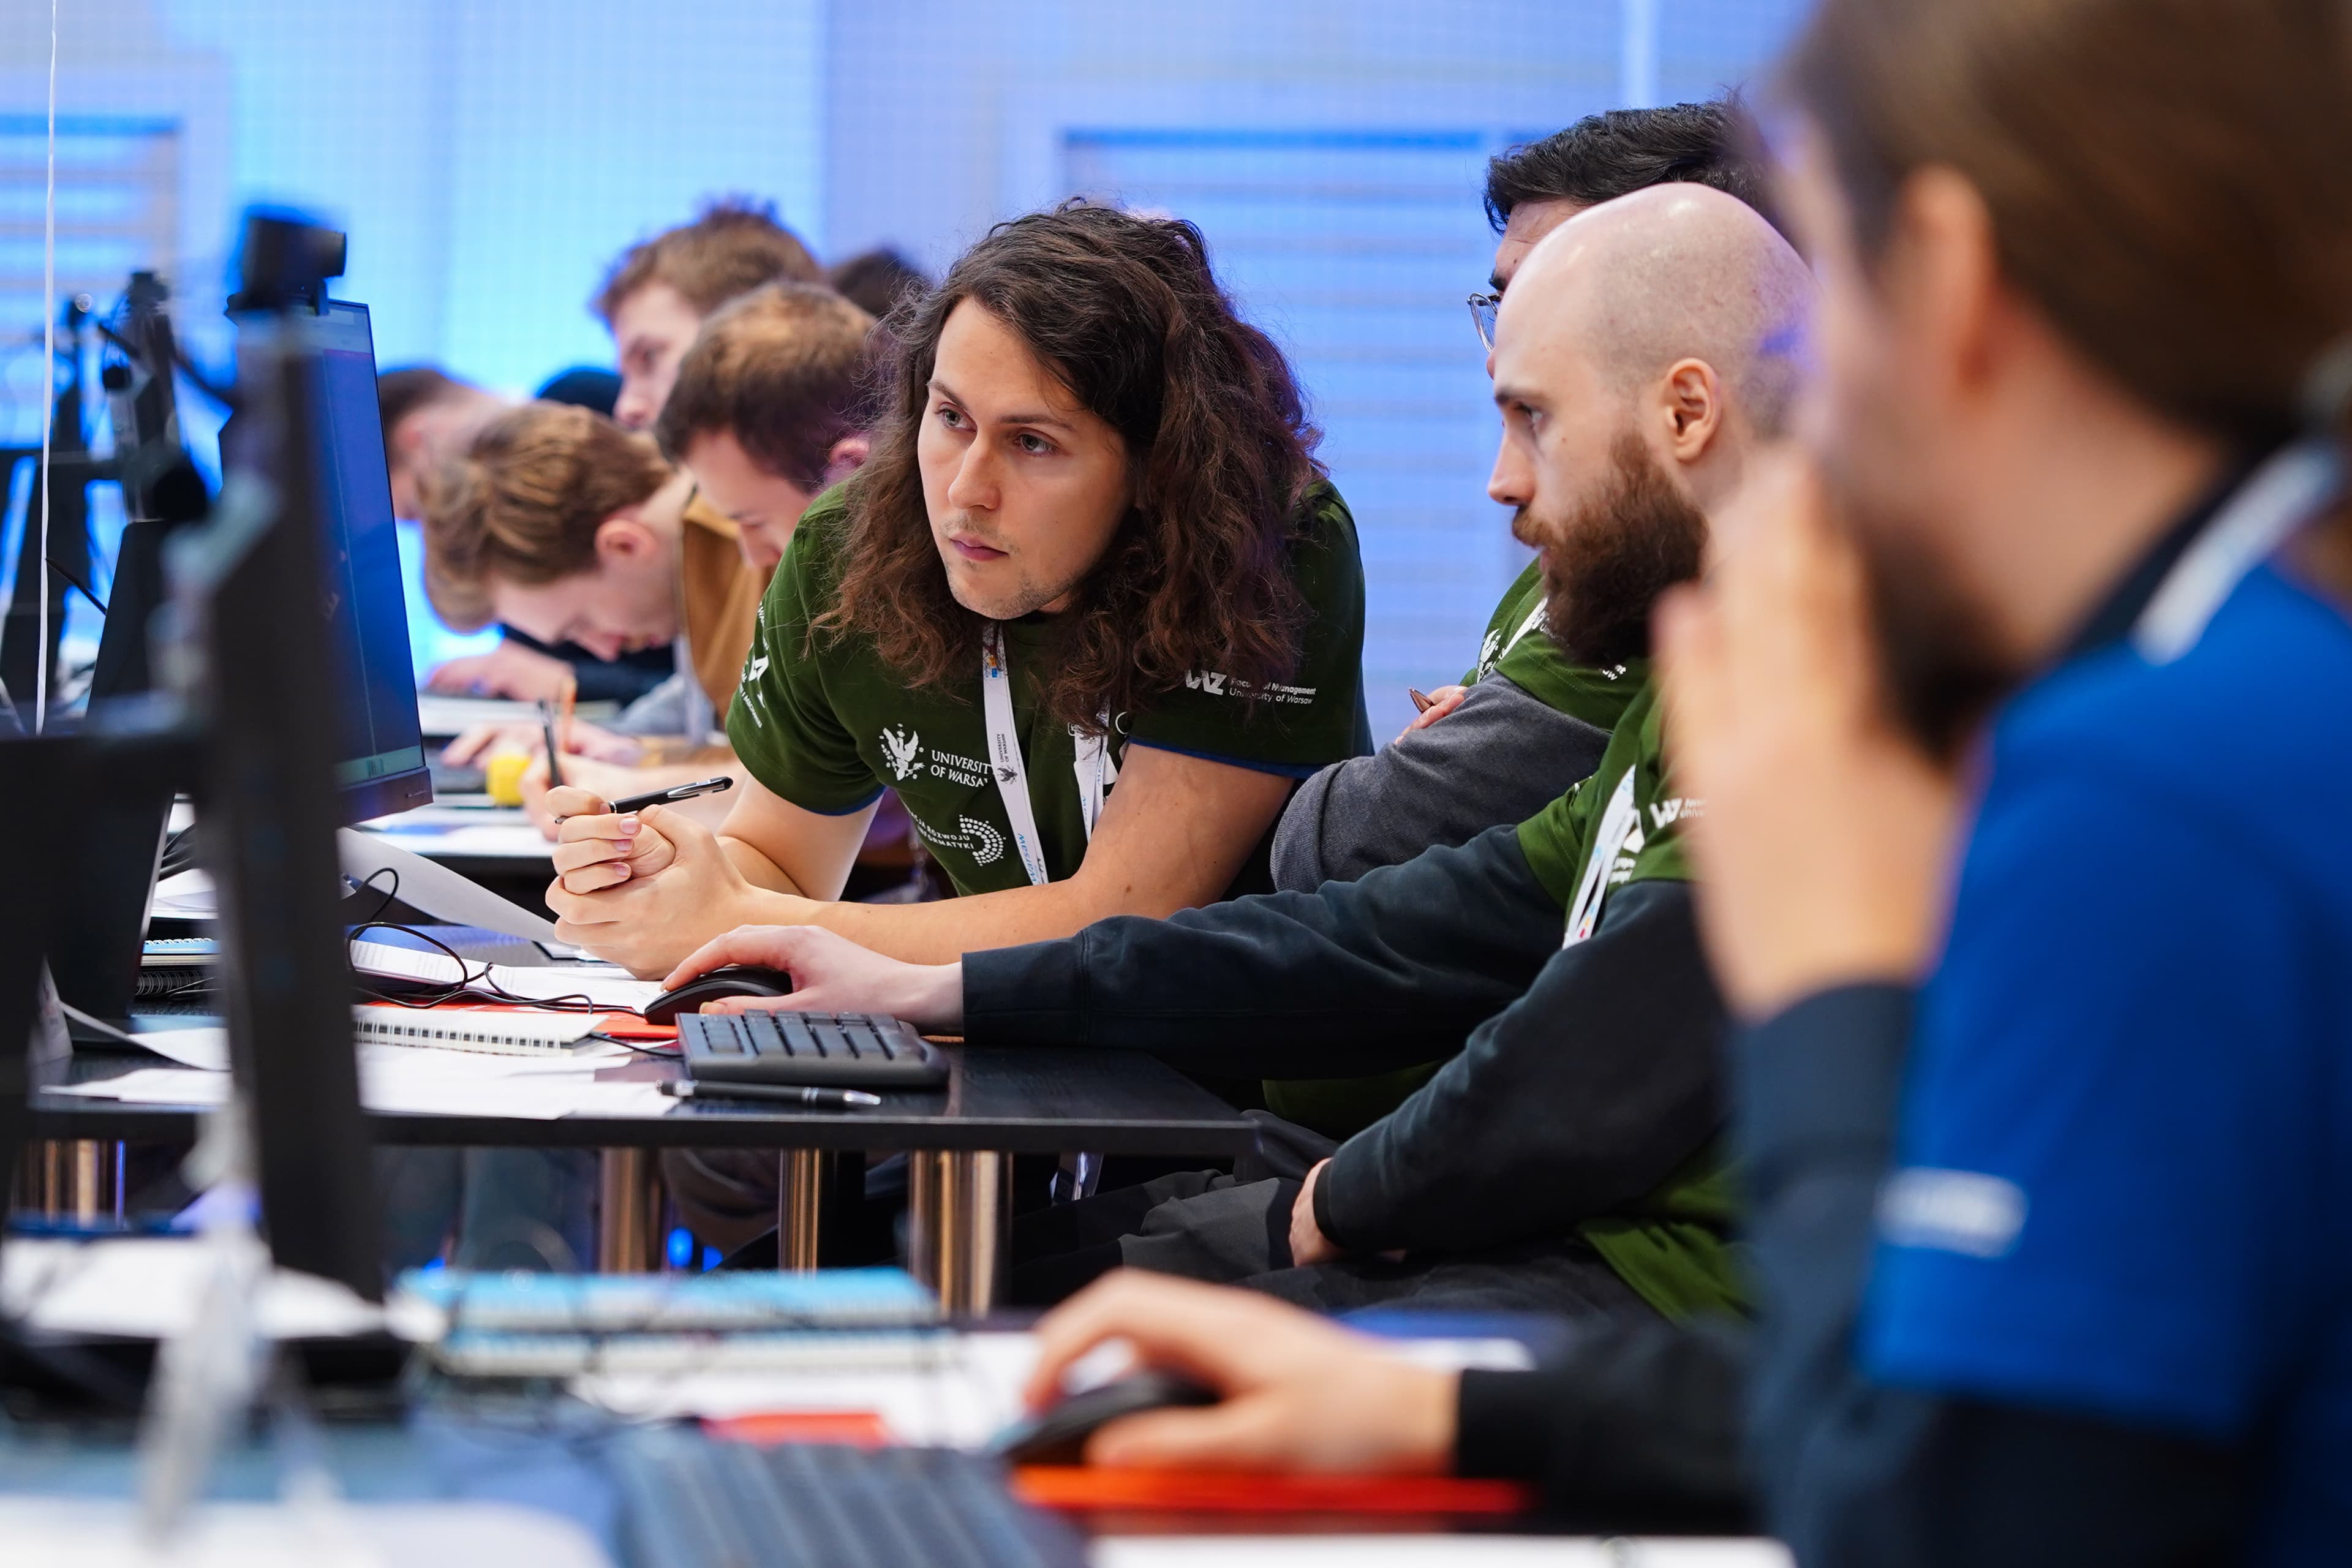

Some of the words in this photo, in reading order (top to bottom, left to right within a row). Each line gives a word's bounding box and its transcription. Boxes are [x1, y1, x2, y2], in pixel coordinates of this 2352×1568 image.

[1229, 687, 1273, 703] Uniity
[1287, 695, 1313, 704] Warsaw
[932, 749, 992, 774] UNIVERSIT
[930, 764, 946, 778] OF
[948, 769, 988, 787] WARSA
[1018, 833, 1037, 881] Warsaw
